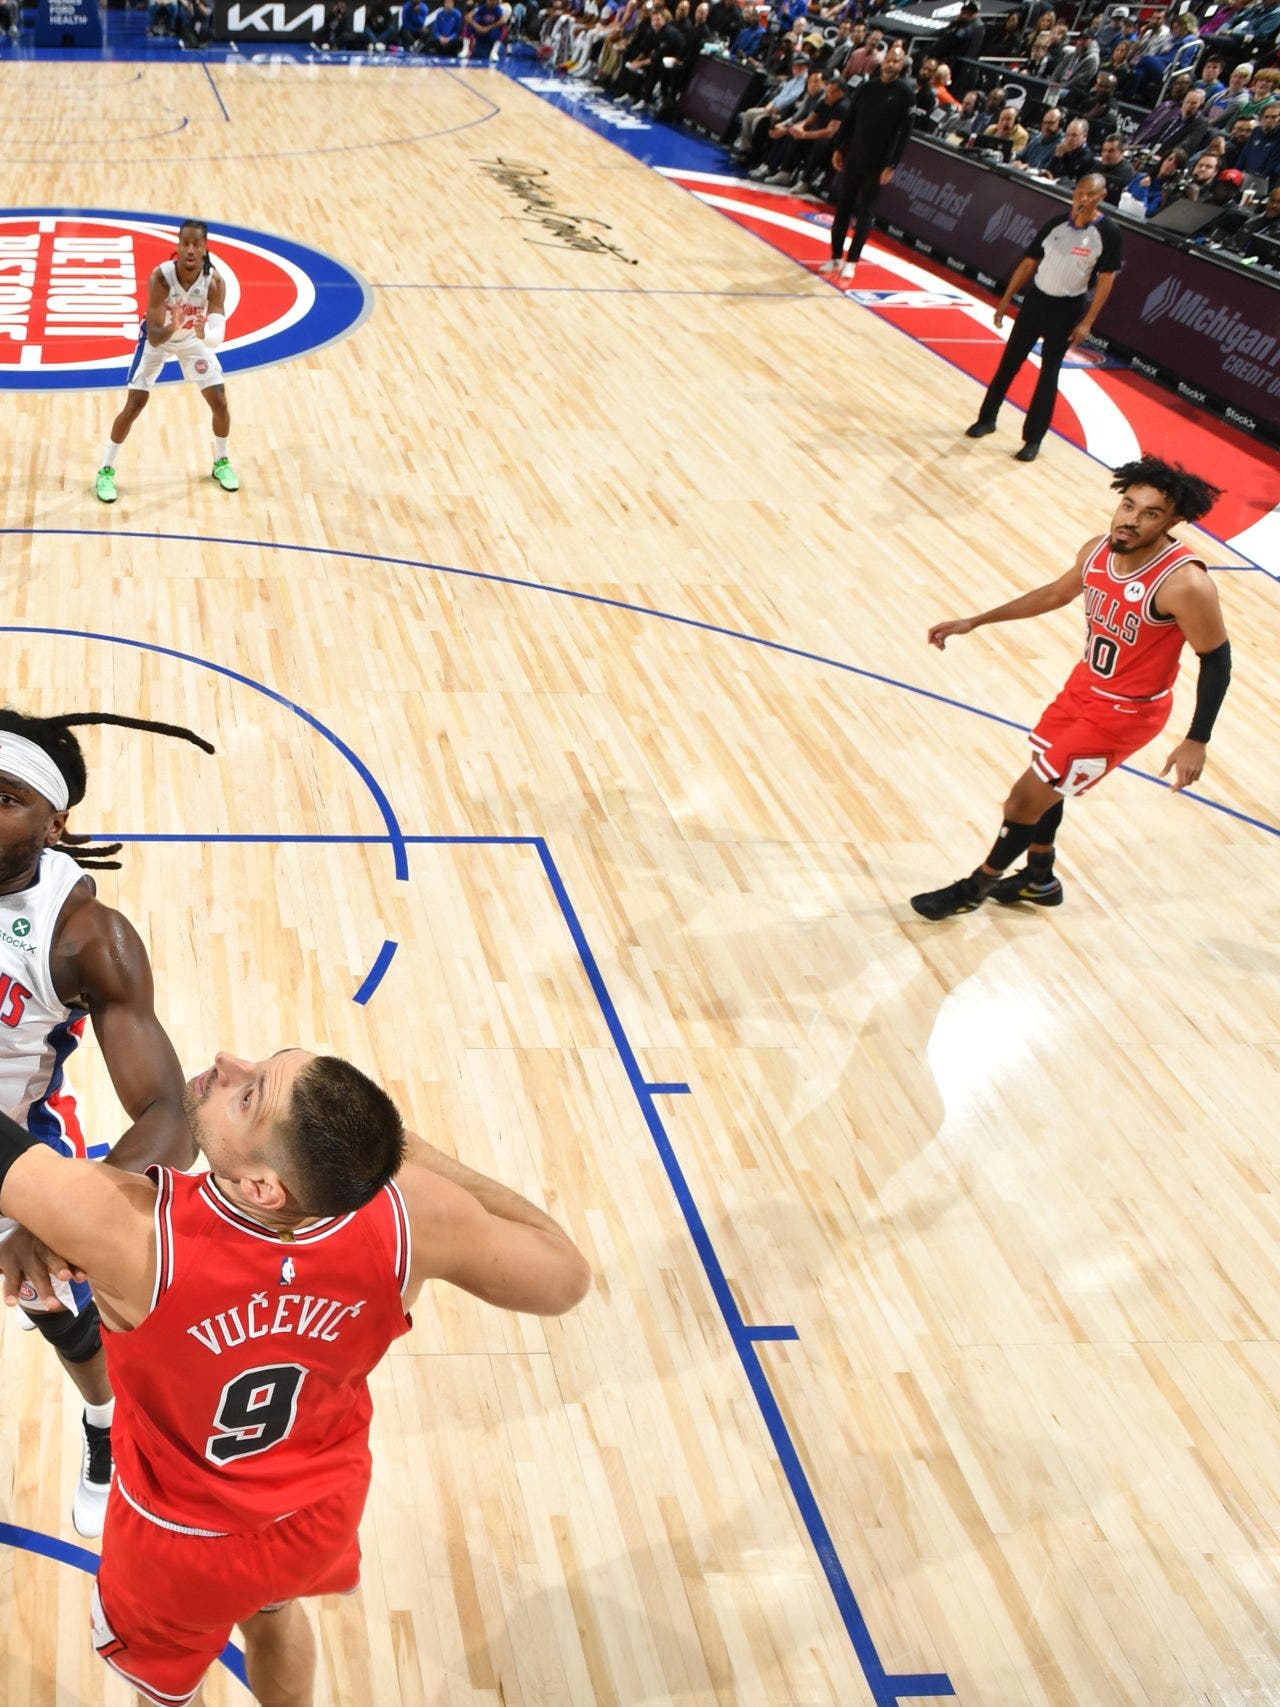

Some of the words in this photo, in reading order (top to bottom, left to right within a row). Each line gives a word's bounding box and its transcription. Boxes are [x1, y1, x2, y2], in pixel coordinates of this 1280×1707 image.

[44, 235, 141, 341] DETROIT
[1168, 289, 1277, 361] Michigan
[1222, 354, 1274, 388] CREDIT
[1083, 584, 1141, 646] ULLS
[186, 1291, 368, 1355] VUČEVIĆ
[205, 1363, 311, 1467] 9
